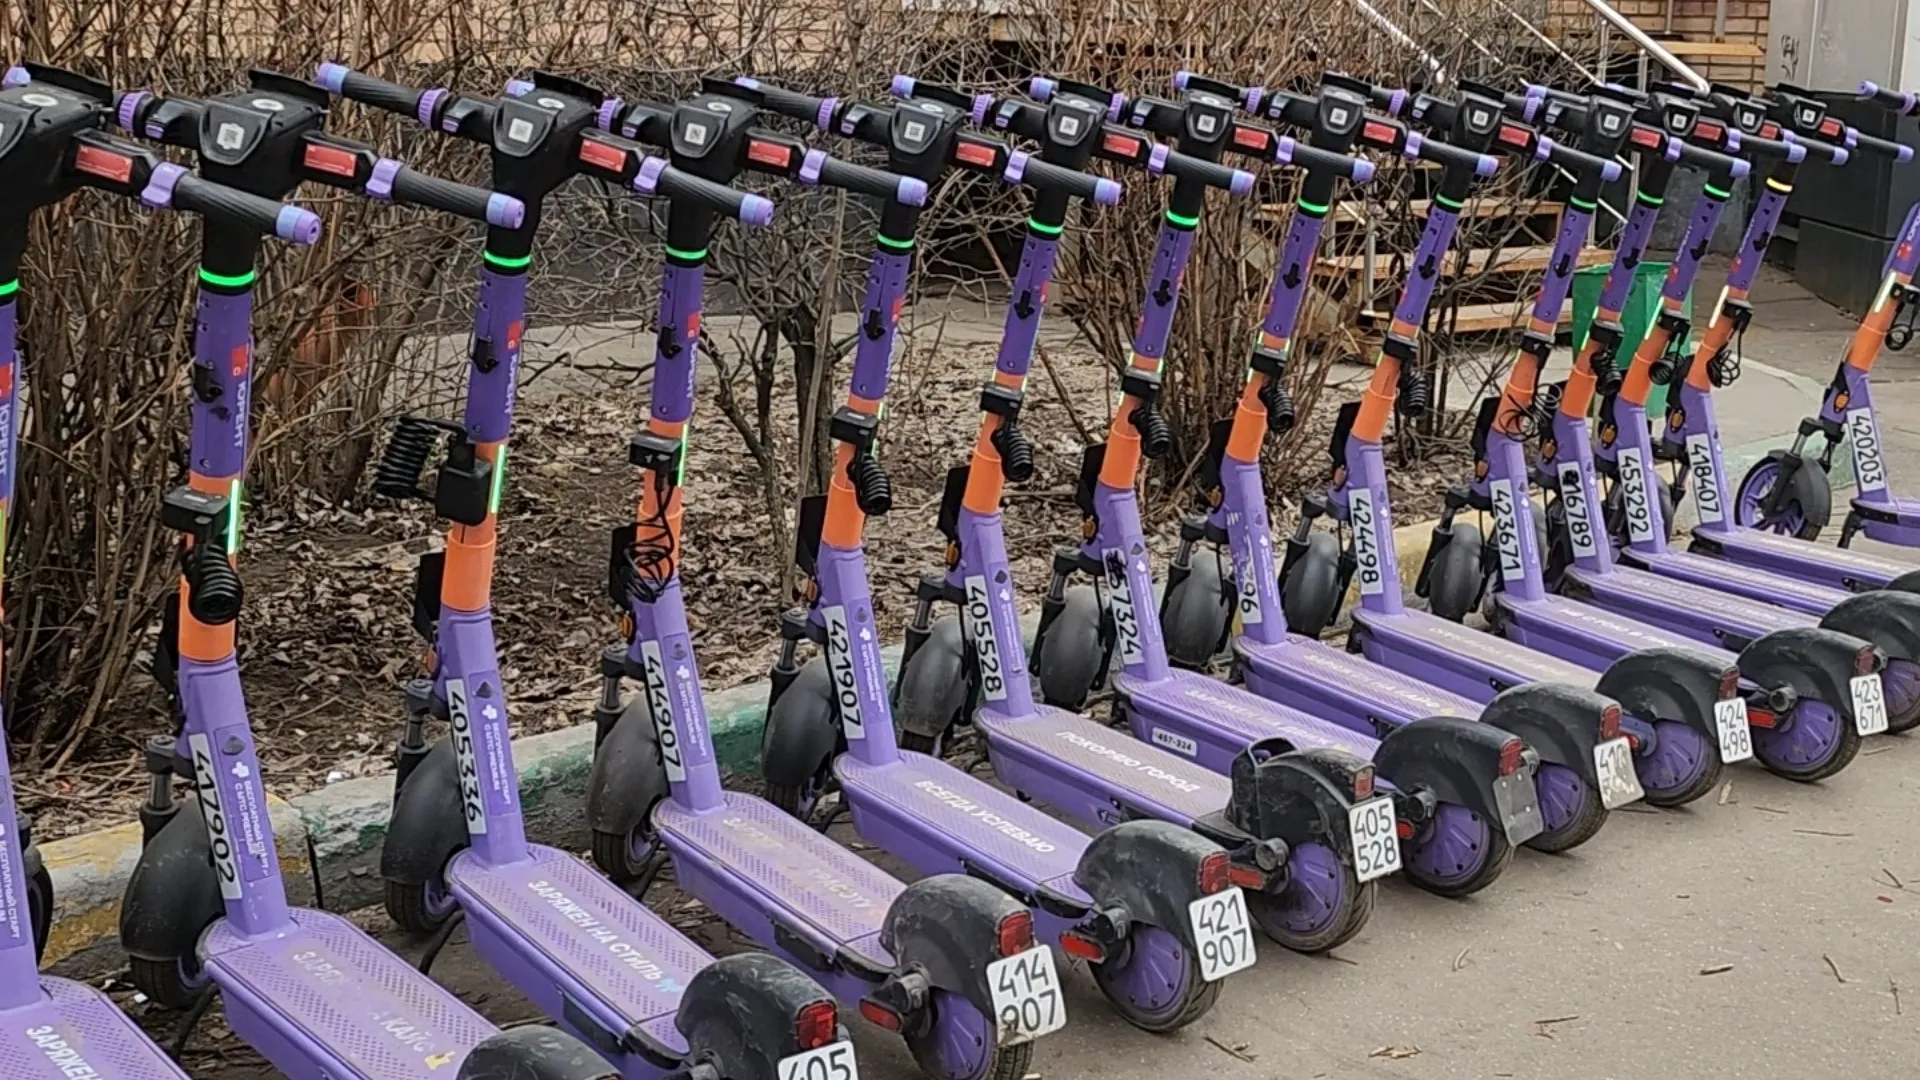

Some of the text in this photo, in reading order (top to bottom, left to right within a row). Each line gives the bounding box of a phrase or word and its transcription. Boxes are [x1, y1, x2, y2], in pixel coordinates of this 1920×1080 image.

[233, 379, 247, 448] ЮРЕНТ
[1852, 415, 1882, 484] 420203
[1620, 455, 1649, 534] 453292
[1691, 443, 1720, 514] 418407
[1493, 488, 1521, 571] 423671
[1562, 469, 1592, 548] 16789
[1353, 497, 1380, 584] 424498
[968, 585, 1003, 693] 405528
[830, 618, 862, 727] 421907
[1855, 678, 1881, 703] 423
[647, 655, 682, 768] 414907
[1720, 701, 1746, 730] 424
[1859, 703, 1885, 730] 671
[450, 690, 483, 823] 405336
[485, 732, 494, 753] МТС
[1156, 732, 1193, 752] 457-324
[1723, 729, 1749, 757] 498
[236, 792, 248, 812] МТС
[1136, 765, 1201, 792] ГОРОД
[196, 750, 236, 883] 417902
[243, 780, 263, 842] БЕСПЛАТНЫЙ
[914, 780, 1057, 853] ВСЕГДА УСПЕВАЮ
[1354, 803, 1392, 840] 405
[1358, 835, 1397, 874] 528
[8, 907, 20, 939] СТАРТ
[527, 880, 665, 981] ЗАРЯЖЕН НА СТИЛЬ
[1199, 893, 1242, 936] 421
[1203, 927, 1247, 974] 907
[999, 952, 1049, 998] 414
[1000, 988, 1056, 1034] 907
[788, 1048, 852, 1080] 405
